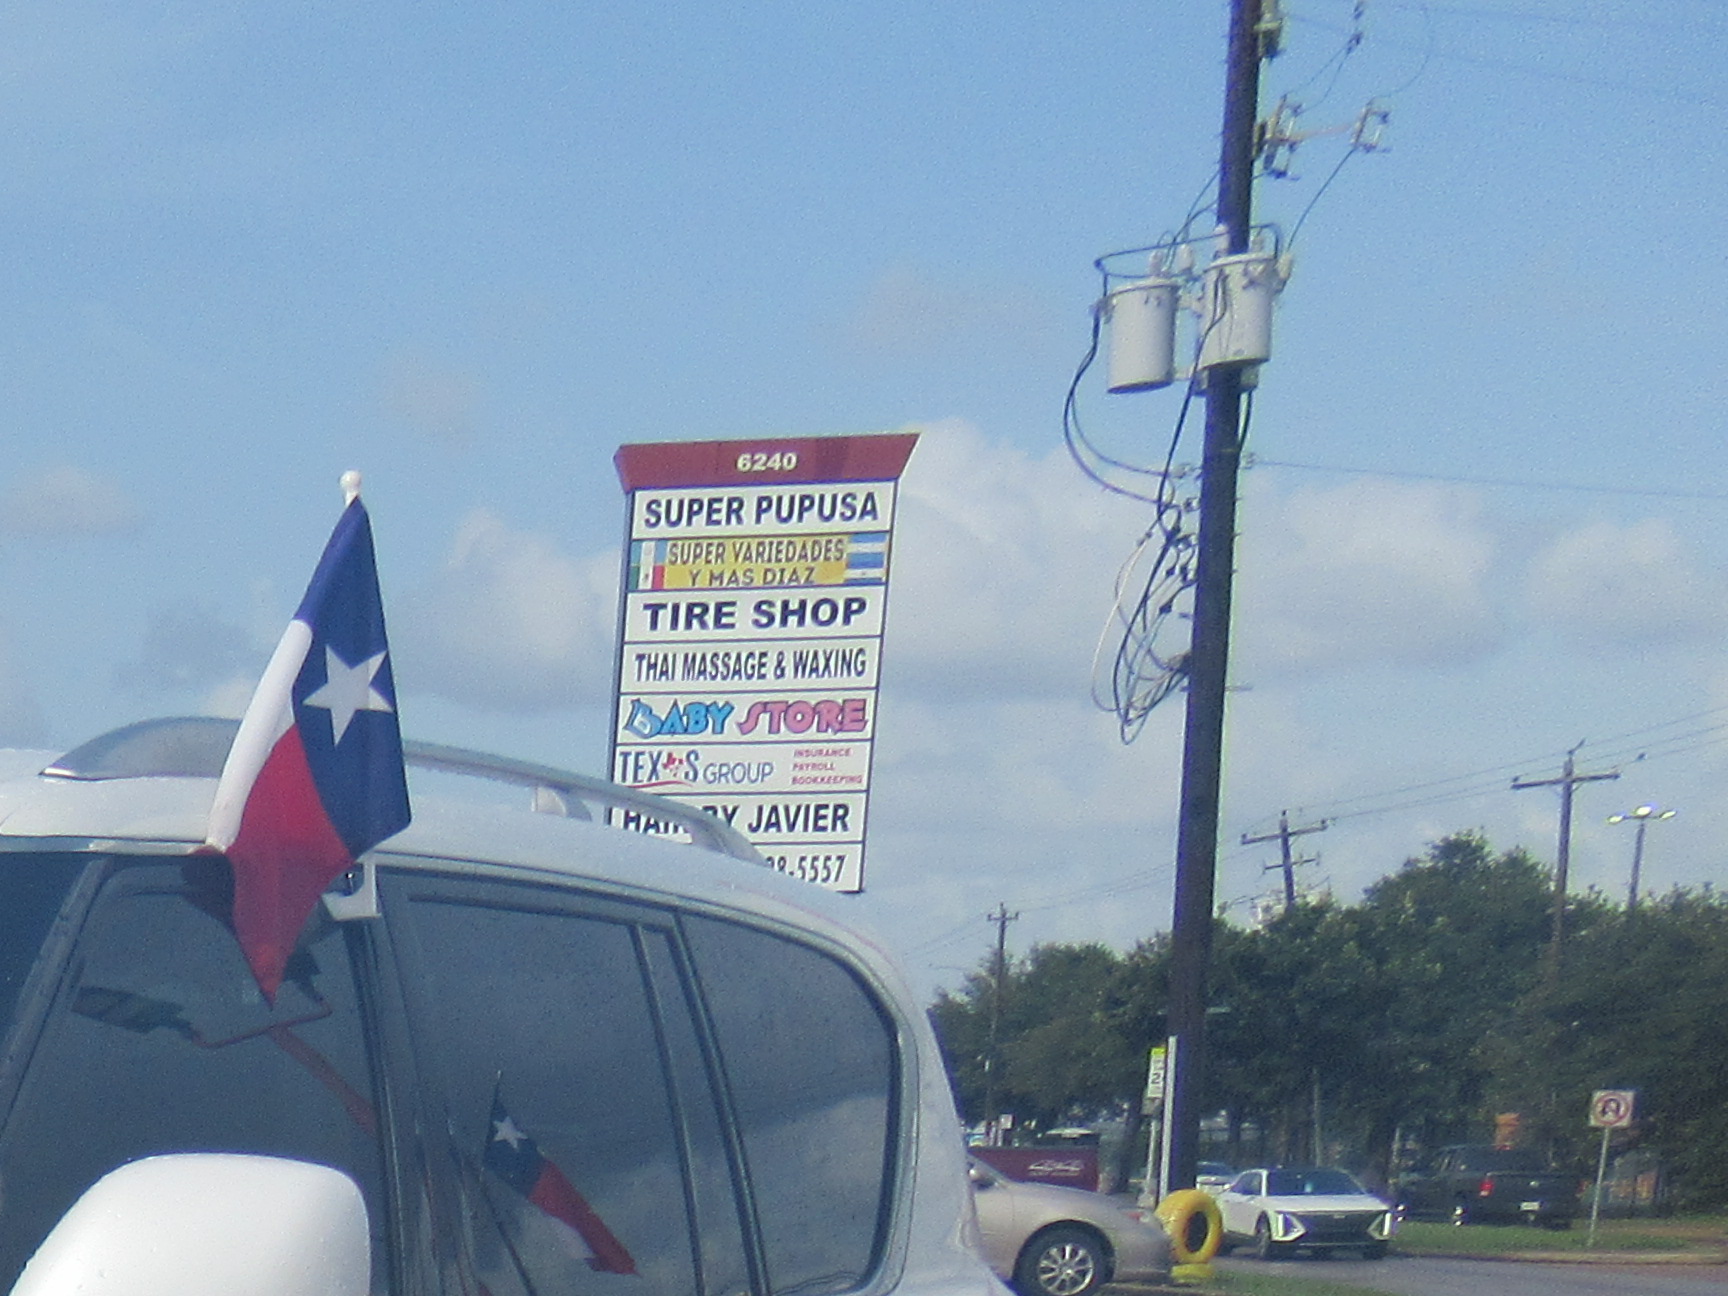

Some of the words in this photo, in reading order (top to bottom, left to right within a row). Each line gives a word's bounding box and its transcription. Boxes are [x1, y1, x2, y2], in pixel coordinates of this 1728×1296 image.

[736, 452, 798, 473] 6240
[644, 495, 744, 528] SUPER
[755, 492, 879, 525] PUPUSA
[667, 541, 726, 565] SUPER
[732, 538, 844, 564] VARIEDADES
[689, 570, 701, 587] Y
[708, 568, 755, 587] MAS
[763, 567, 816, 585] DIAZ
[643, 601, 737, 631] TIRE
[751, 597, 868, 629] SHOP
[635, 652, 676, 682] THAI
[681, 650, 768, 681] MASSAGE
[773, 651, 786, 680] &
[793, 648, 867, 679] WAXING
[623, 698, 736, 738] BABY
[736, 698, 869, 735] STORE
[703, 761, 775, 784] GROUP
[746, 803, 850, 834] JAVIER
